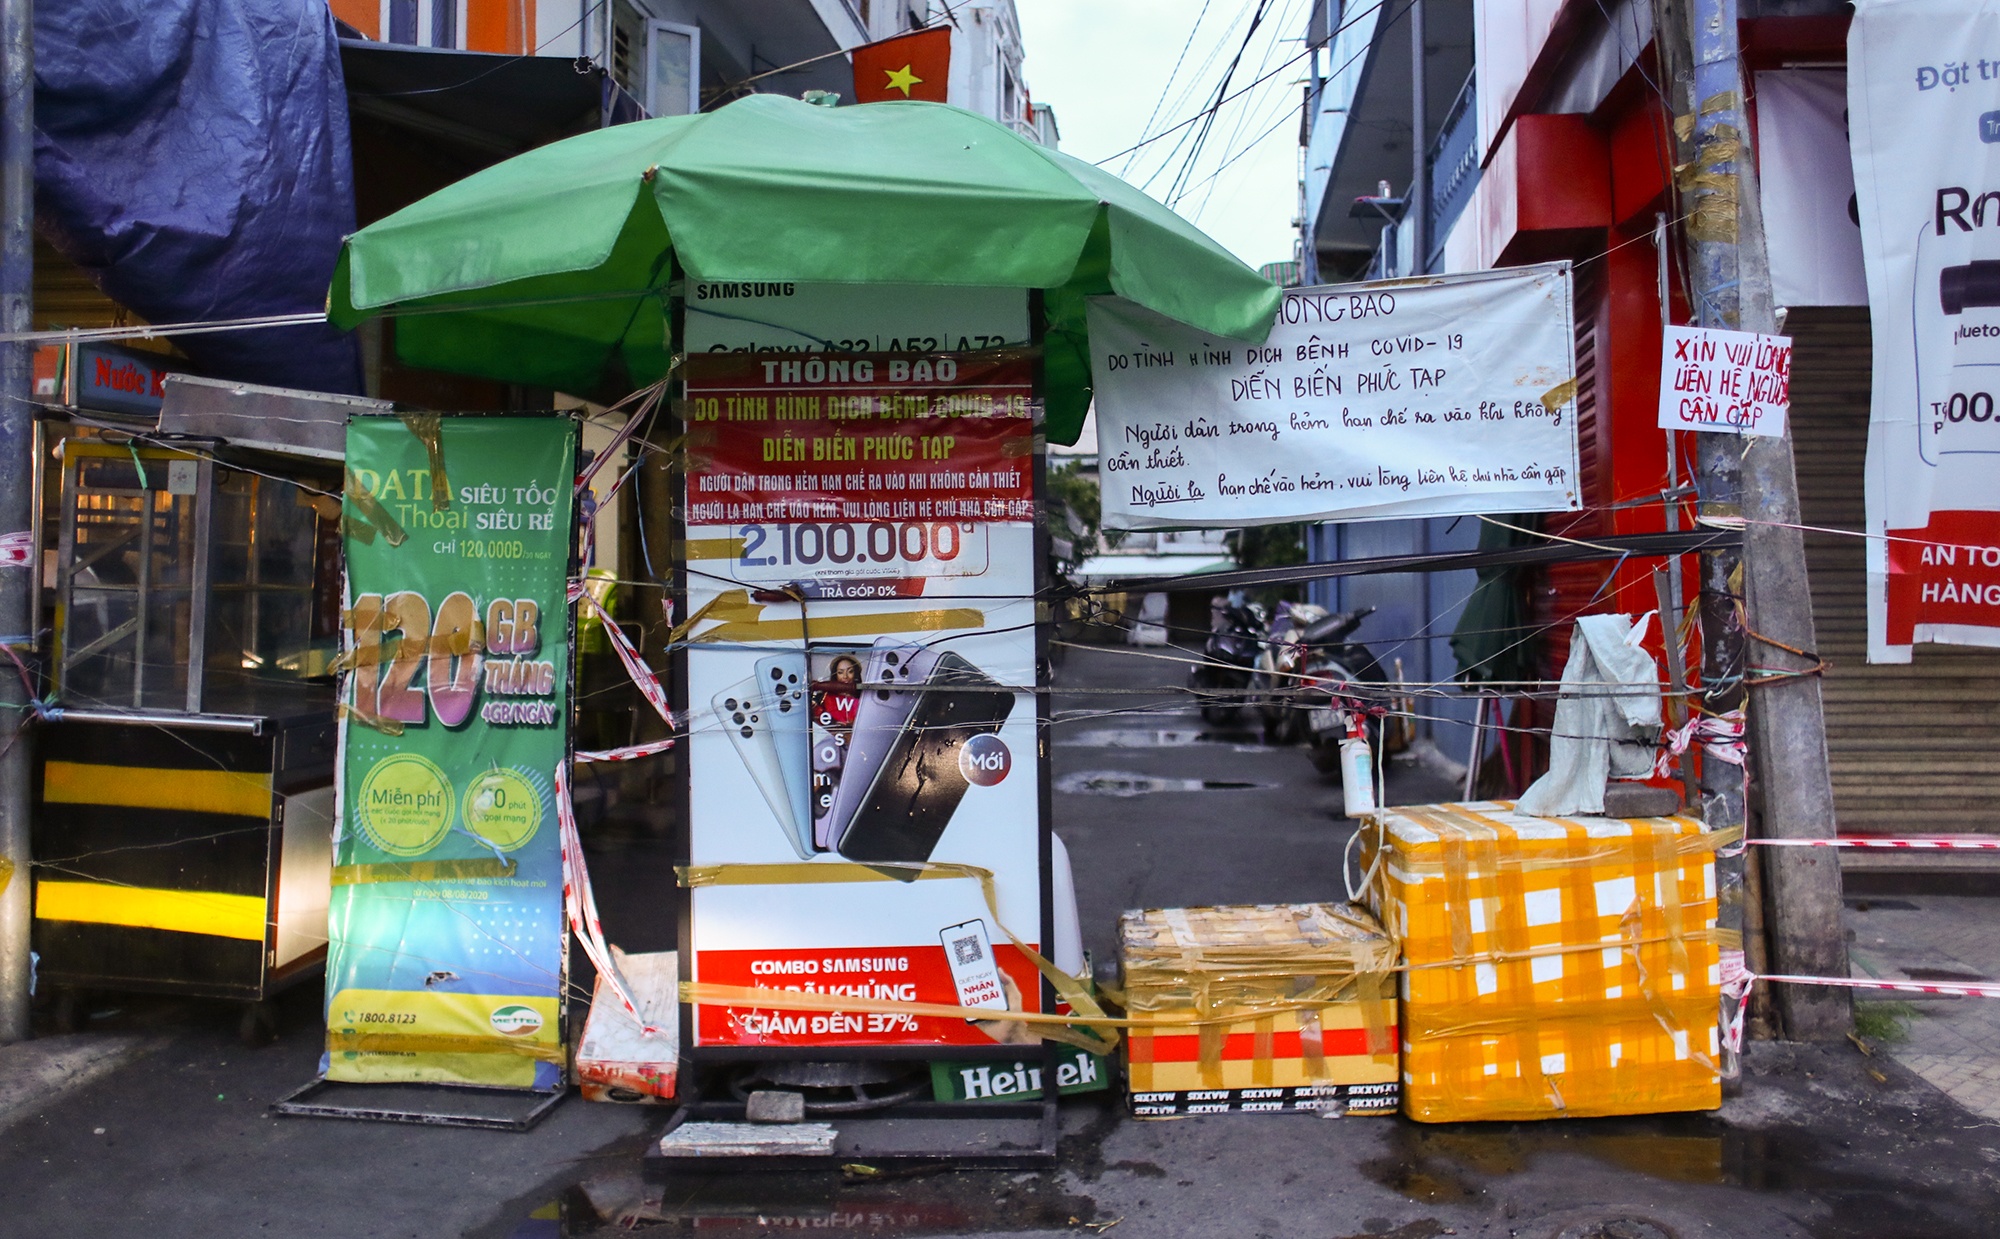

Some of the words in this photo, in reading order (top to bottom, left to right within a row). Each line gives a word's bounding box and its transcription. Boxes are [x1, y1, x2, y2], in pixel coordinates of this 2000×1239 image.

[1915, 61, 1969, 92] Đặt
[697, 281, 795, 299] SAMSUNG
[1108, 354, 1128, 371] DO
[1133, 343, 1174, 368] TÌNH
[1247, 346, 1282, 368] DỊCH
[1296, 335, 1349, 364] BỆNH
[95, 357, 145, 395] Nước
[761, 356, 874, 383] THÔNG
[1231, 370, 1282, 401] DIỄN
[1294, 364, 1342, 398] BIẾN
[1358, 364, 1401, 394] PHỨC
[1410, 368, 1446, 397] TẠP
[1674, 364, 1712, 394] LIÊN
[695, 398, 719, 421] DO
[726, 392, 768, 421] TÌNH
[776, 392, 820, 420] HÌNH
[828, 396, 872, 426] DỊCH
[880, 391, 928, 424] BỆNH
[1680, 396, 1718, 422] CẦN
[1184, 417, 1220, 438] dân
[1229, 422, 1280, 440] trong
[1289, 412, 1329, 429] hẻm
[1342, 407, 1372, 431] hạn
[1380, 408, 1408, 426] chế
[1415, 412, 1436, 423] ra
[763, 428, 805, 462] DIỄN
[814, 428, 855, 461] BIẾN
[864, 431, 913, 460] PHỨC
[921, 435, 955, 465] TẠP
[353, 468, 455, 500] DATA
[460, 482, 506, 505] SIÊU
[513, 479, 557, 505] TỐC
[700, 473, 731, 492] NGƯỜI
[735, 472, 755, 491] DÂN
[759, 475, 791, 491] TRONG
[795, 470, 818, 490] HẺM
[822, 474, 841, 494] HẠN
[845, 468, 865, 490] CHẾ
[869, 474, 881, 490] RA
[885, 471, 905, 489] VÀO
[909, 474, 926, 489] KHI
[930, 470, 965, 488] KHÔNG
[969, 467, 989, 488] CẦN
[992, 466, 1020, 488] THIẾT
[1218, 474, 1245, 499] hạn
[1348, 472, 1372, 488] vui
[1418, 468, 1445, 486] liên
[1521, 463, 1541, 480] cần
[395, 503, 468, 535] Thoại
[476, 508, 522, 530] SIÊU
[528, 508, 554, 530] RẺ
[692, 500, 723, 519] NGƯỜI
[743, 503, 763, 521] HẠN
[767, 497, 786, 519] CHẾ
[790, 499, 809, 518] VÀO
[843, 502, 860, 518] VUI
[864, 499, 889, 518] LÒNG
[894, 498, 915, 517] LIÊN
[919, 498, 931, 520] HỆ
[935, 496, 955, 516] CHỦ
[433, 539, 456, 553] CHỈ
[460, 540, 523, 558] 120.000Đ
[820, 584, 843, 597] TRẢ
[847, 584, 874, 597] GÓP
[878, 585, 896, 596] 0%
[353, 590, 482, 727] 120
[486, 598, 538, 655] GB
[484, 655, 554, 695] THÁNG
[481, 699, 556, 725] 4GB/NGÀY
[968, 751, 1004, 772] Mới
[372, 788, 412, 806] Miễn
[417, 791, 441, 809] phí
[441, 890, 488, 900] 08/08/2020
[750, 959, 819, 976] COMBO
[822, 957, 909, 973] SAMSUNG
[964, 981, 994, 995] NHẬN
[965, 997, 980, 1006] ƯU
[982, 991, 1000, 1001] ĐÃI
[359, 1012, 416, 1024] 1800.8123
[745, 1011, 806, 1035] GIẢM
[868, 1013, 919, 1033] 37%
